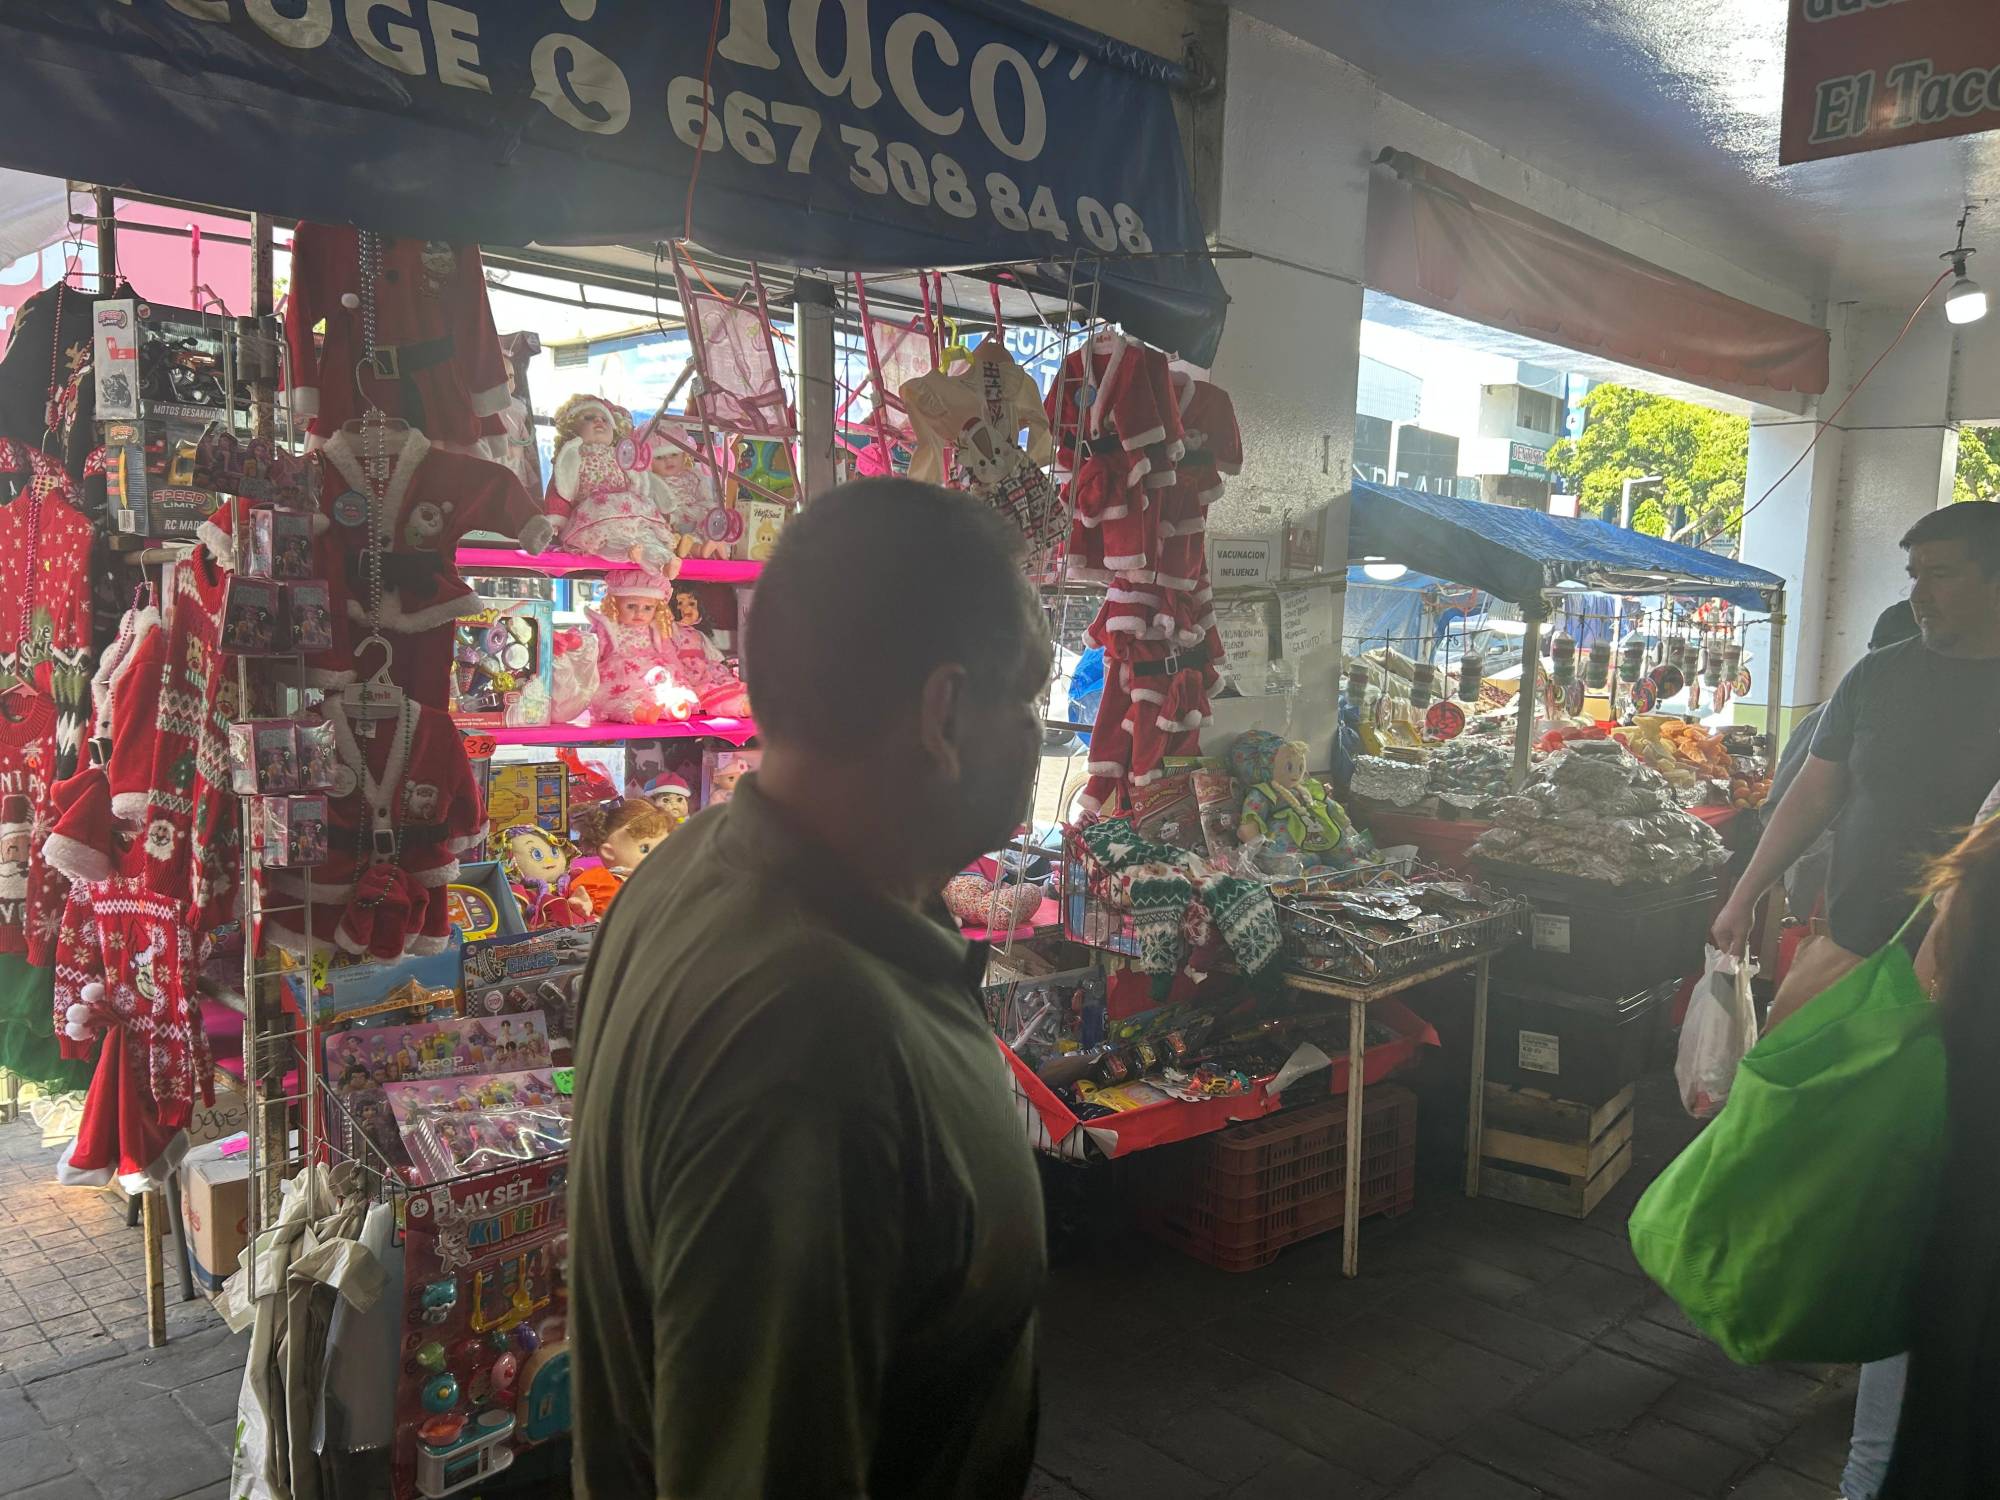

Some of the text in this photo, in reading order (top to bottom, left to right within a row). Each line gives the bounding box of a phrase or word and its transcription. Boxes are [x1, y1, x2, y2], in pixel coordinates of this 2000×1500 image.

[163, 0, 492, 94] OGE
[1808, 70, 1875, 144] El
[667, 76, 1152, 254] 667 308 84 08
[153, 404, 180, 416] MOTOS
[152, 489, 208, 504] SPEED
[164, 519, 177, 530] RC
[1217, 550, 1265, 560] VACUNACION
[1220, 568, 1259, 577] INFLUENZA
[492, 1178, 533, 1206] SET
[466, 1199, 559, 1249] KITCH
